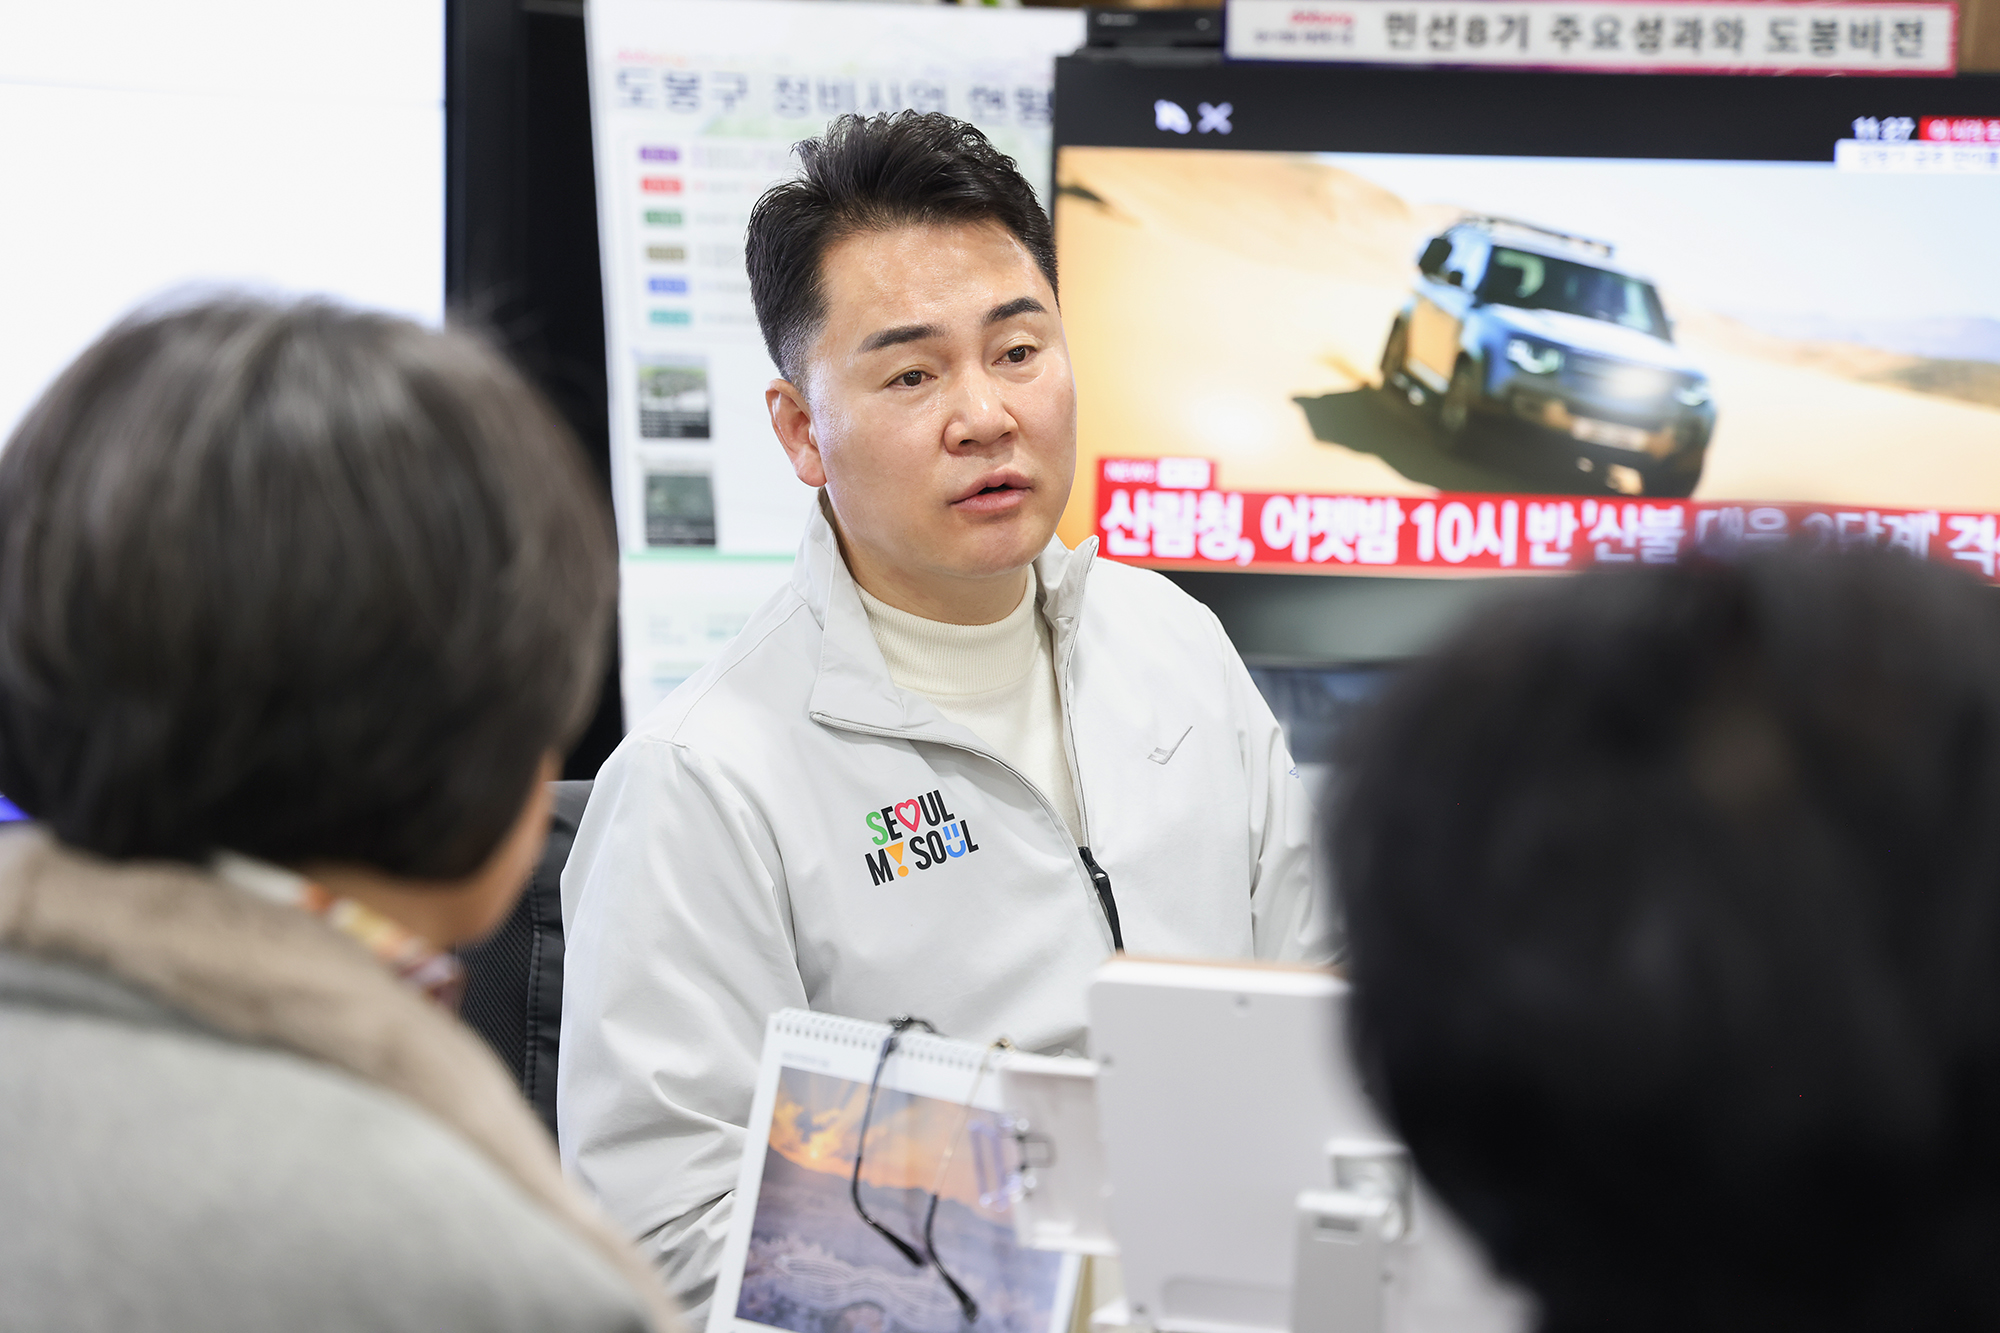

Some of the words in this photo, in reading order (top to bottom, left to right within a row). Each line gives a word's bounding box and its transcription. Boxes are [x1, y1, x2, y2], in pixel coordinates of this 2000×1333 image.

[1385, 9, 1530, 53] 민선8기
[1549, 12, 1745, 55] 주요성과와
[1764, 15, 1925, 58] 도봉비전
[616, 67, 748, 115] 도봉구
[1100, 487, 1256, 567] 산림청,
[1259, 493, 1406, 565] 어젯밤
[1410, 499, 1519, 567] 10시
[1524, 500, 1580, 567] 반
[909, 819, 980, 871] SOUL
